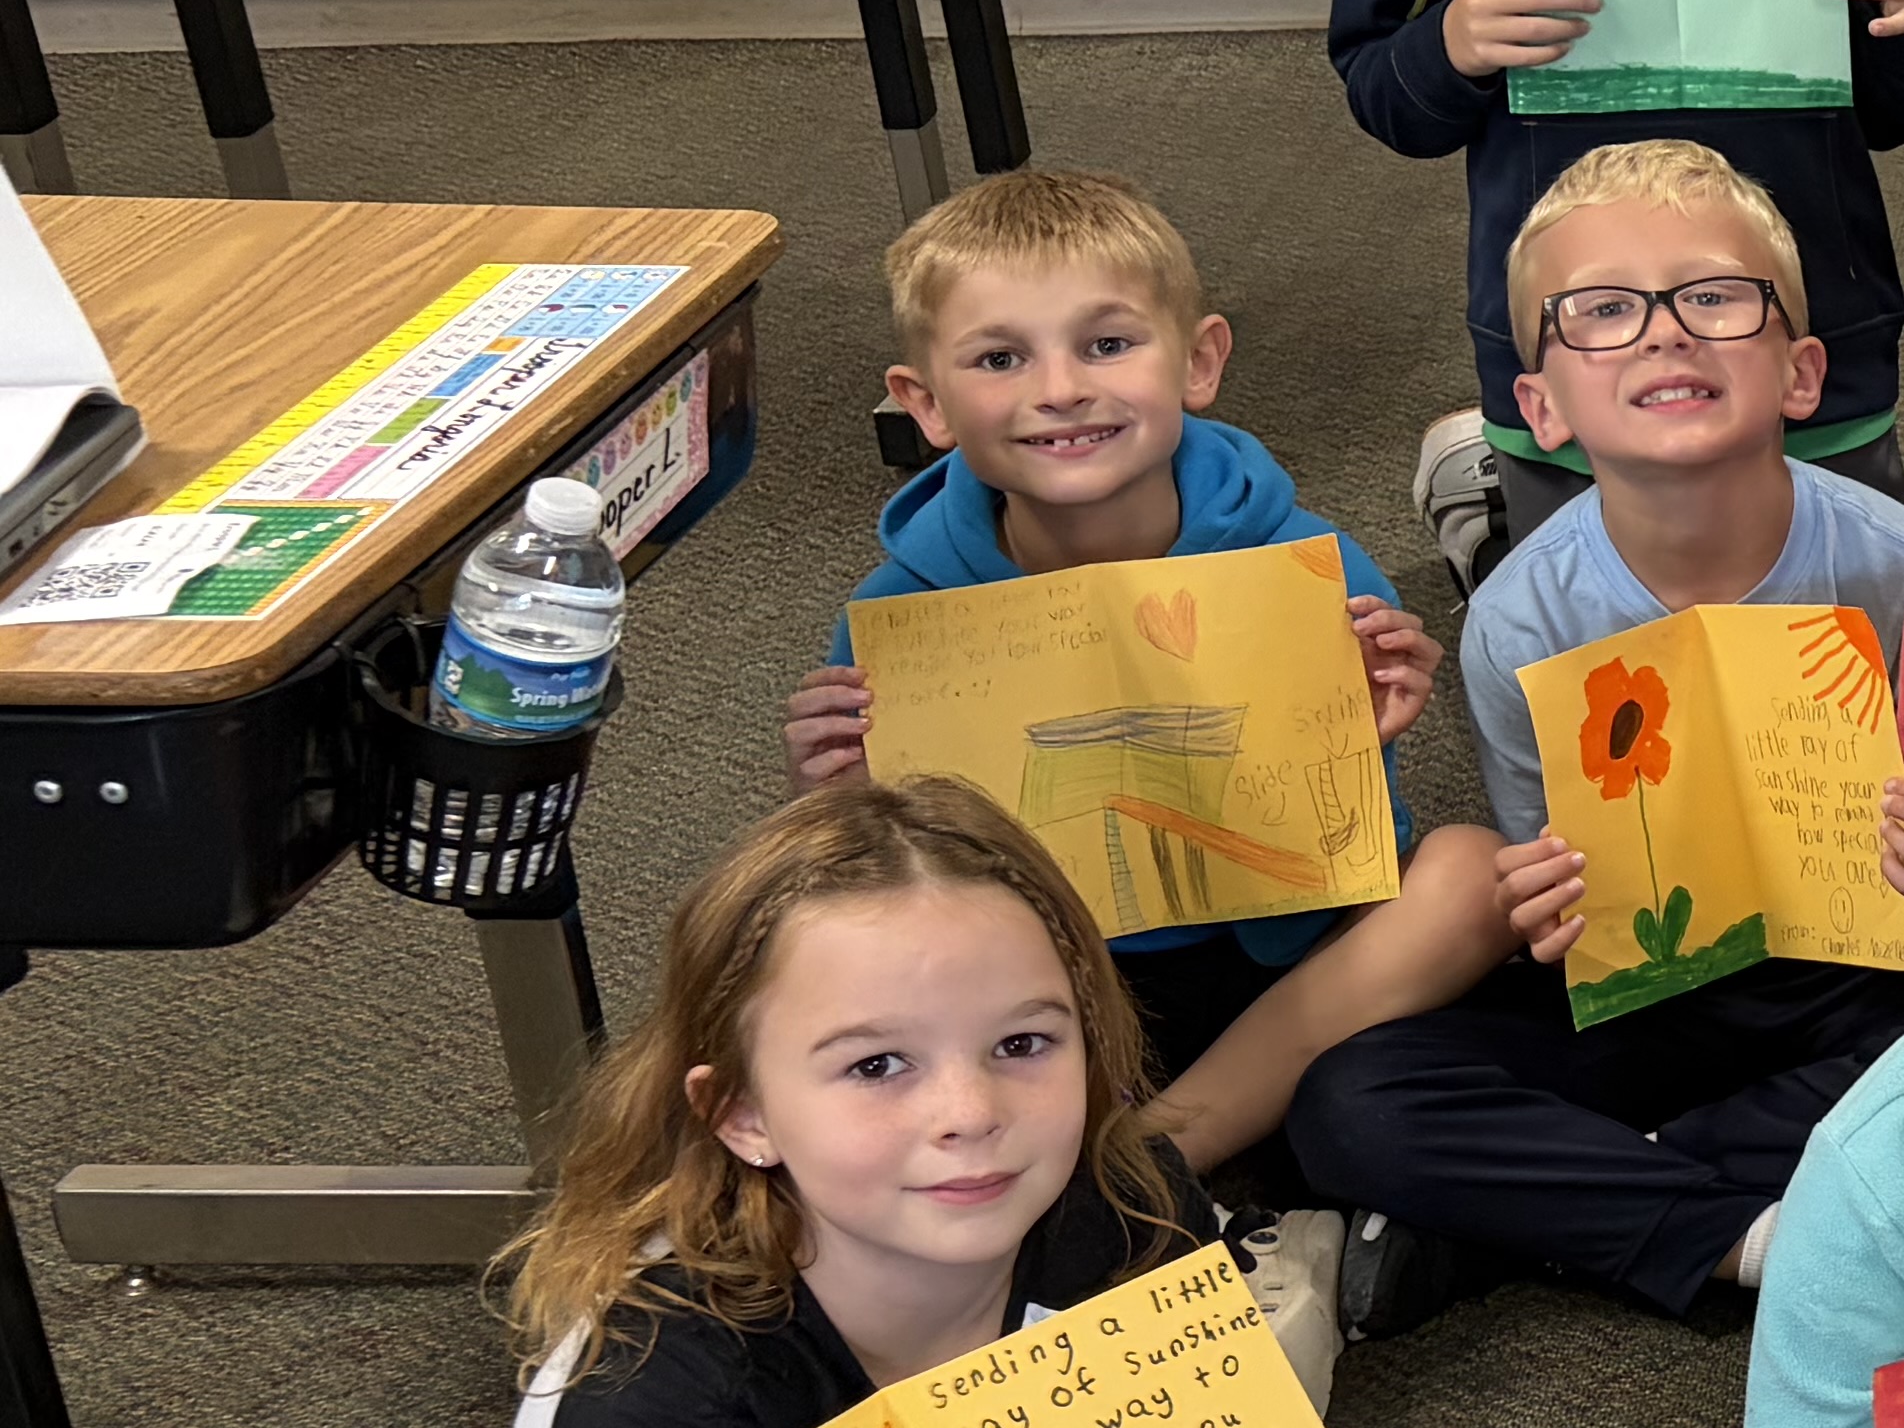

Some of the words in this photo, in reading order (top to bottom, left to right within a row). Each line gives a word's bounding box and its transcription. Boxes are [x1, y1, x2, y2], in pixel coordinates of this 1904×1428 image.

[510, 686, 569, 708] Spring
[1745, 729, 1788, 762] little
[1800, 735, 1827, 764] ray
[1835, 734, 1858, 763] of
[1100, 1317, 1125, 1335] a
[1149, 1261, 1234, 1314] little
[1050, 1366, 1097, 1407] of
[1194, 1354, 1239, 1388] to
